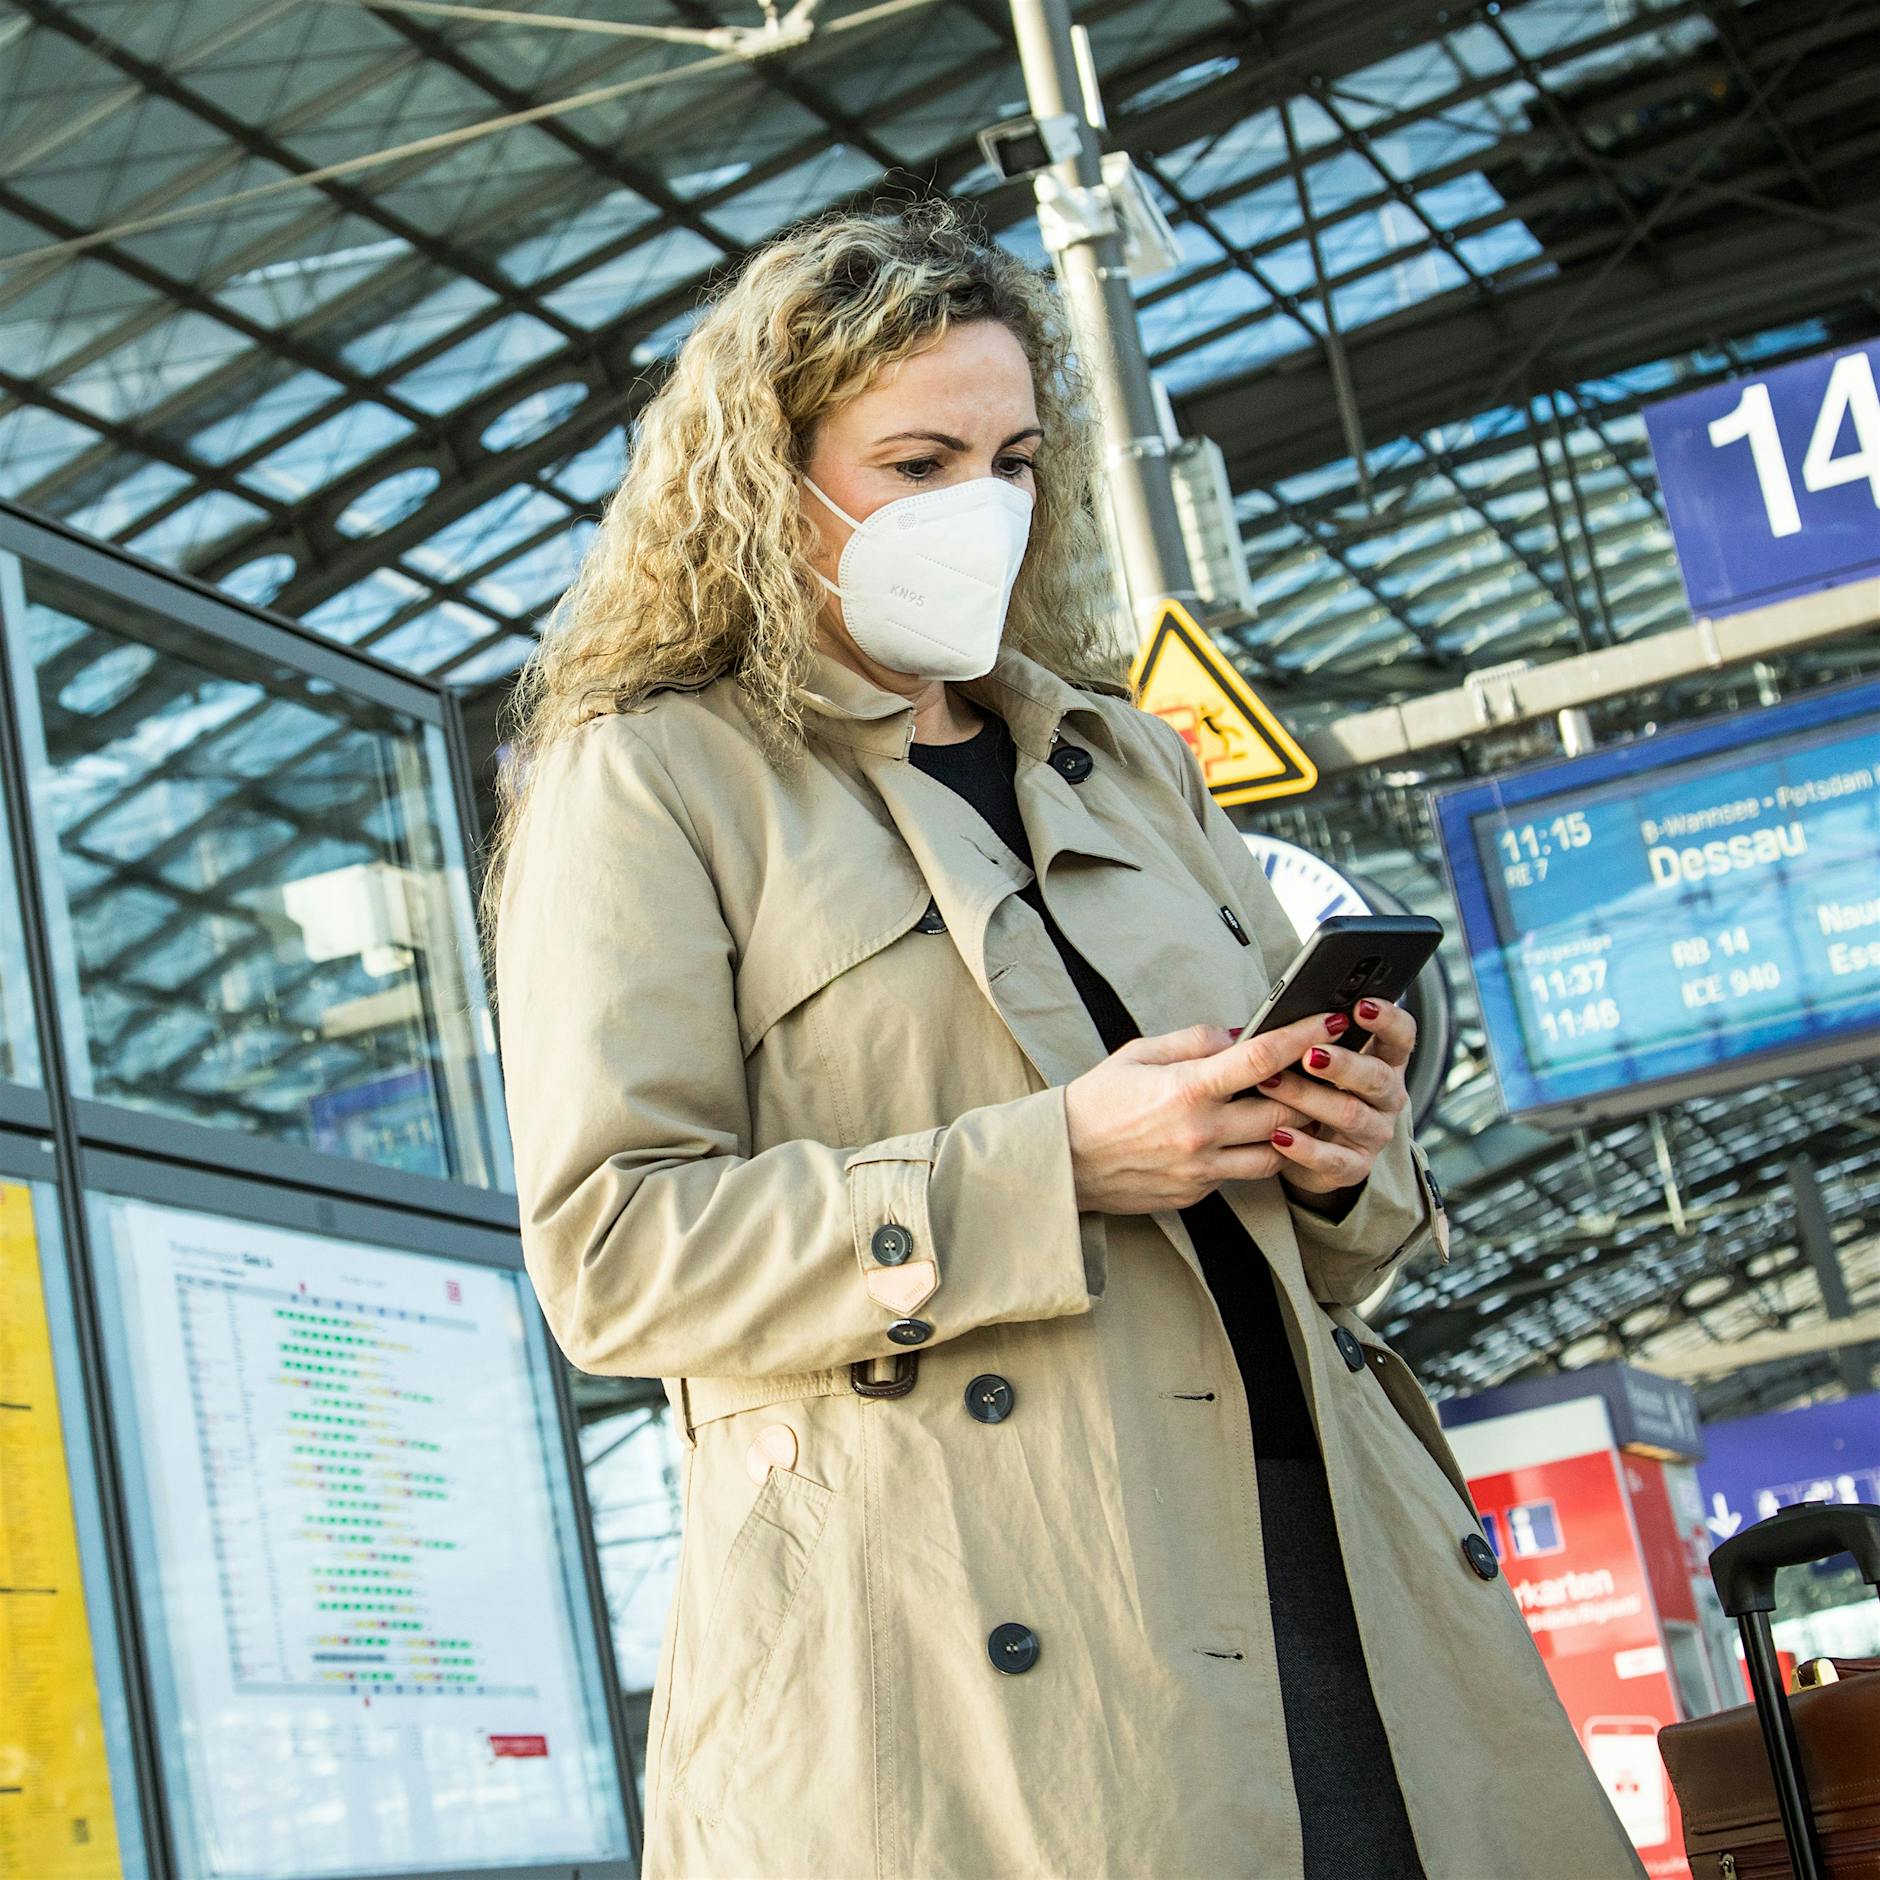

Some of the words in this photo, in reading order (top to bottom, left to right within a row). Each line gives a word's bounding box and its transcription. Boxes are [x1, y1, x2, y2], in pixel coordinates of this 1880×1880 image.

[1707, 351, 1880, 538] 14
[889, 583, 926, 608] KN95
[1775, 769, 1874, 811] Potsdam
[1501, 811, 1592, 863] 11:15
[1648, 821, 1808, 889] Dessau
[1533, 857, 1548, 882] 7
[1530, 958, 1608, 1003] 11:37
[1671, 936, 1711, 969] RB
[1717, 926, 1750, 958] 14
[1681, 974, 1726, 1009] ICE
[1729, 961, 1781, 998] 940
[1513, 1568, 1615, 1610] rkarten
